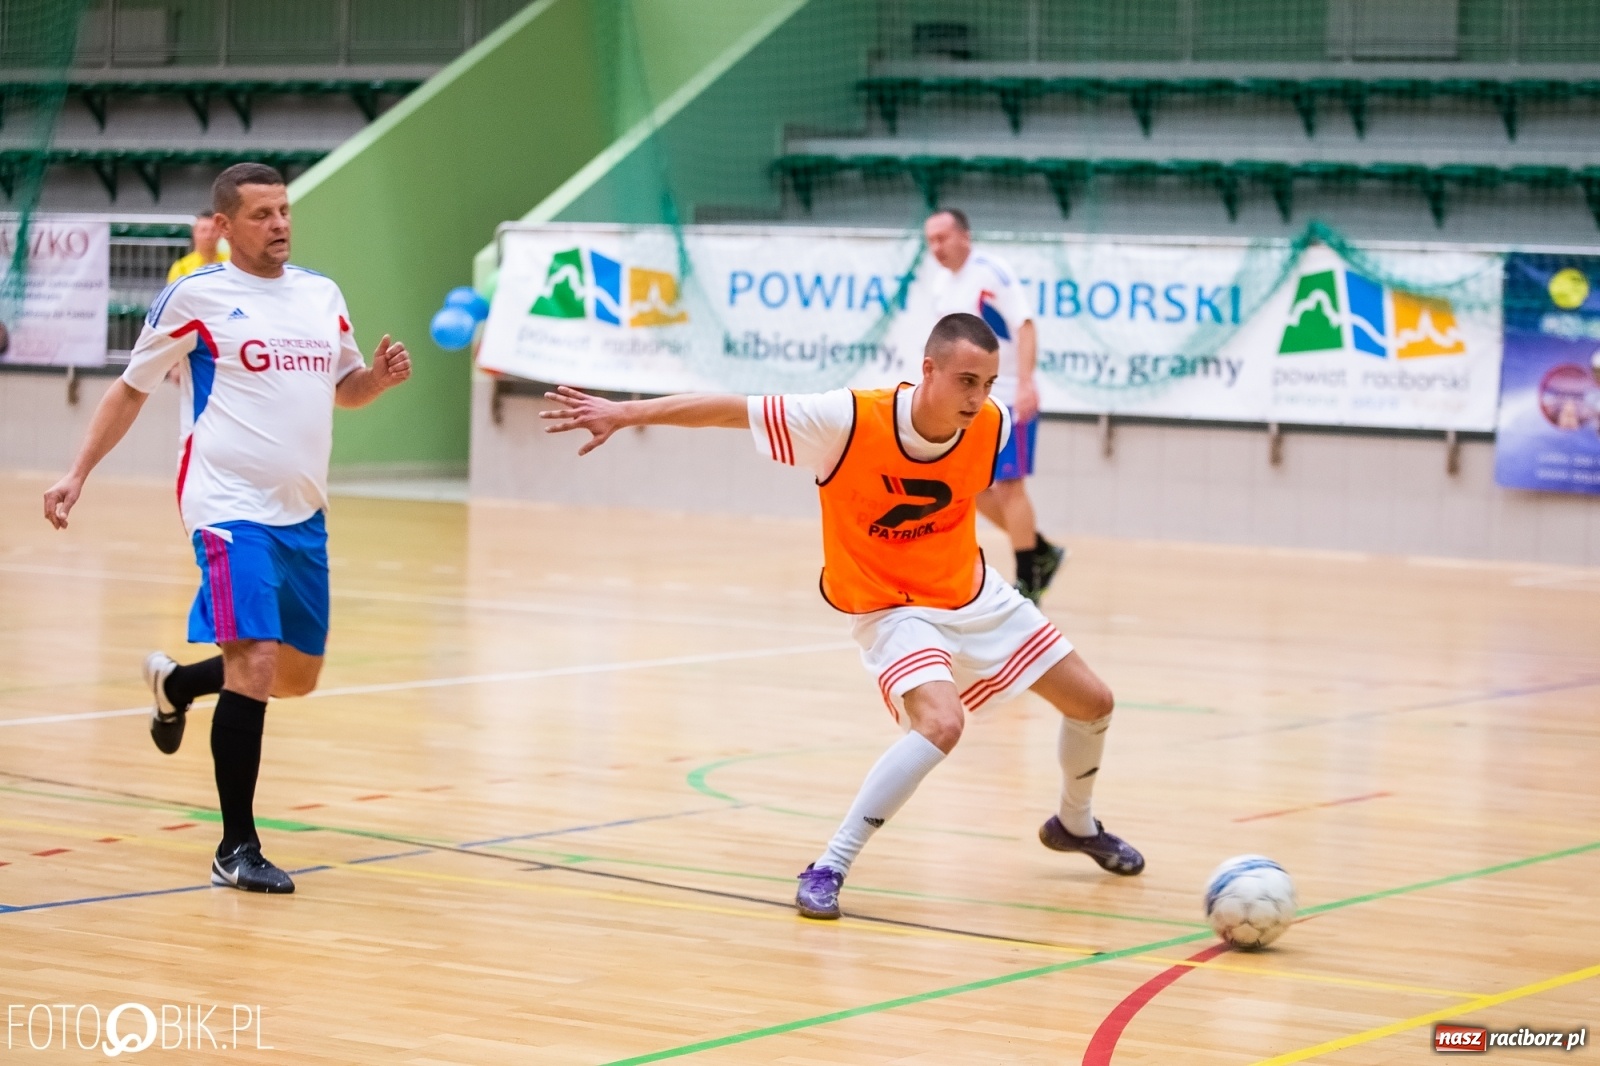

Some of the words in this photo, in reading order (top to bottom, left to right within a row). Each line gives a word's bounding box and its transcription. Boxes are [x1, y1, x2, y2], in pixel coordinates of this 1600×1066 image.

[728, 270, 912, 311] POWIAT
[1020, 278, 1242, 325] IBORSKI
[240, 339, 332, 373] Gianni
[269, 338, 331, 349] CUKIERNIA
[723, 331, 904, 371] kibicujemy,
[1128, 355, 1245, 393] gramy
[1272, 367, 1347, 388] powiat
[868, 521, 936, 539] PATRICK
